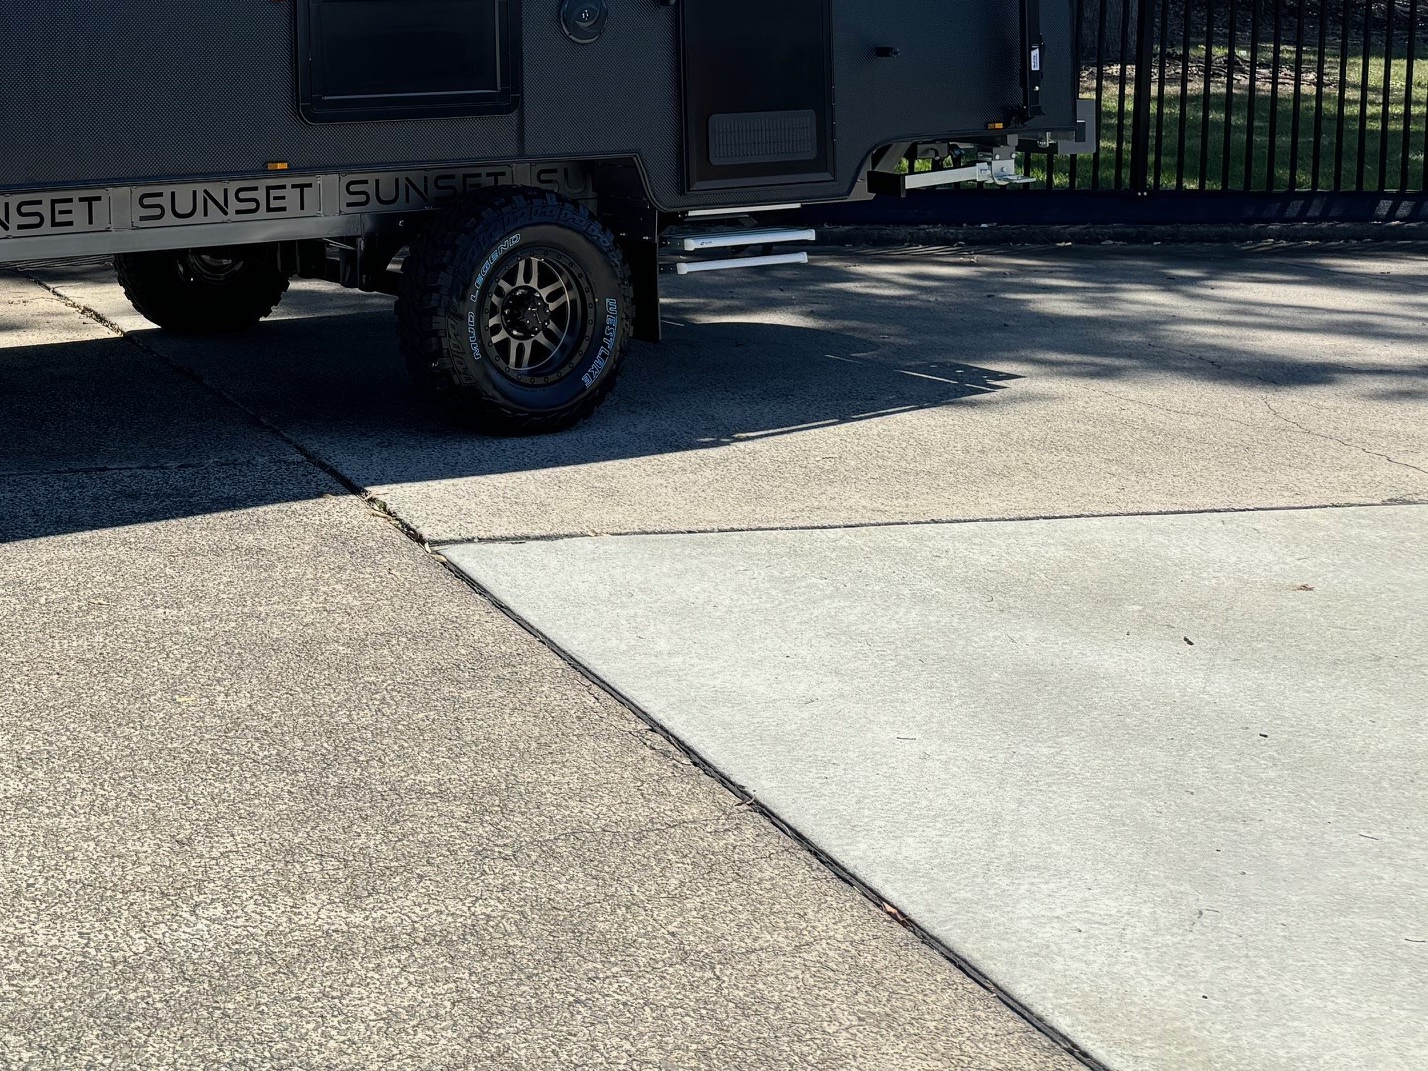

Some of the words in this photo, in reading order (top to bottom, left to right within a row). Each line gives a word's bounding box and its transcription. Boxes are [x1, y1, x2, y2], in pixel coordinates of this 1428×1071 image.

[138, 182, 313, 222] SUNSET
[470, 233, 521, 303] LEGEND
[468, 311, 482, 360] MUD
[581, 297, 618, 389] WESTLAKE
